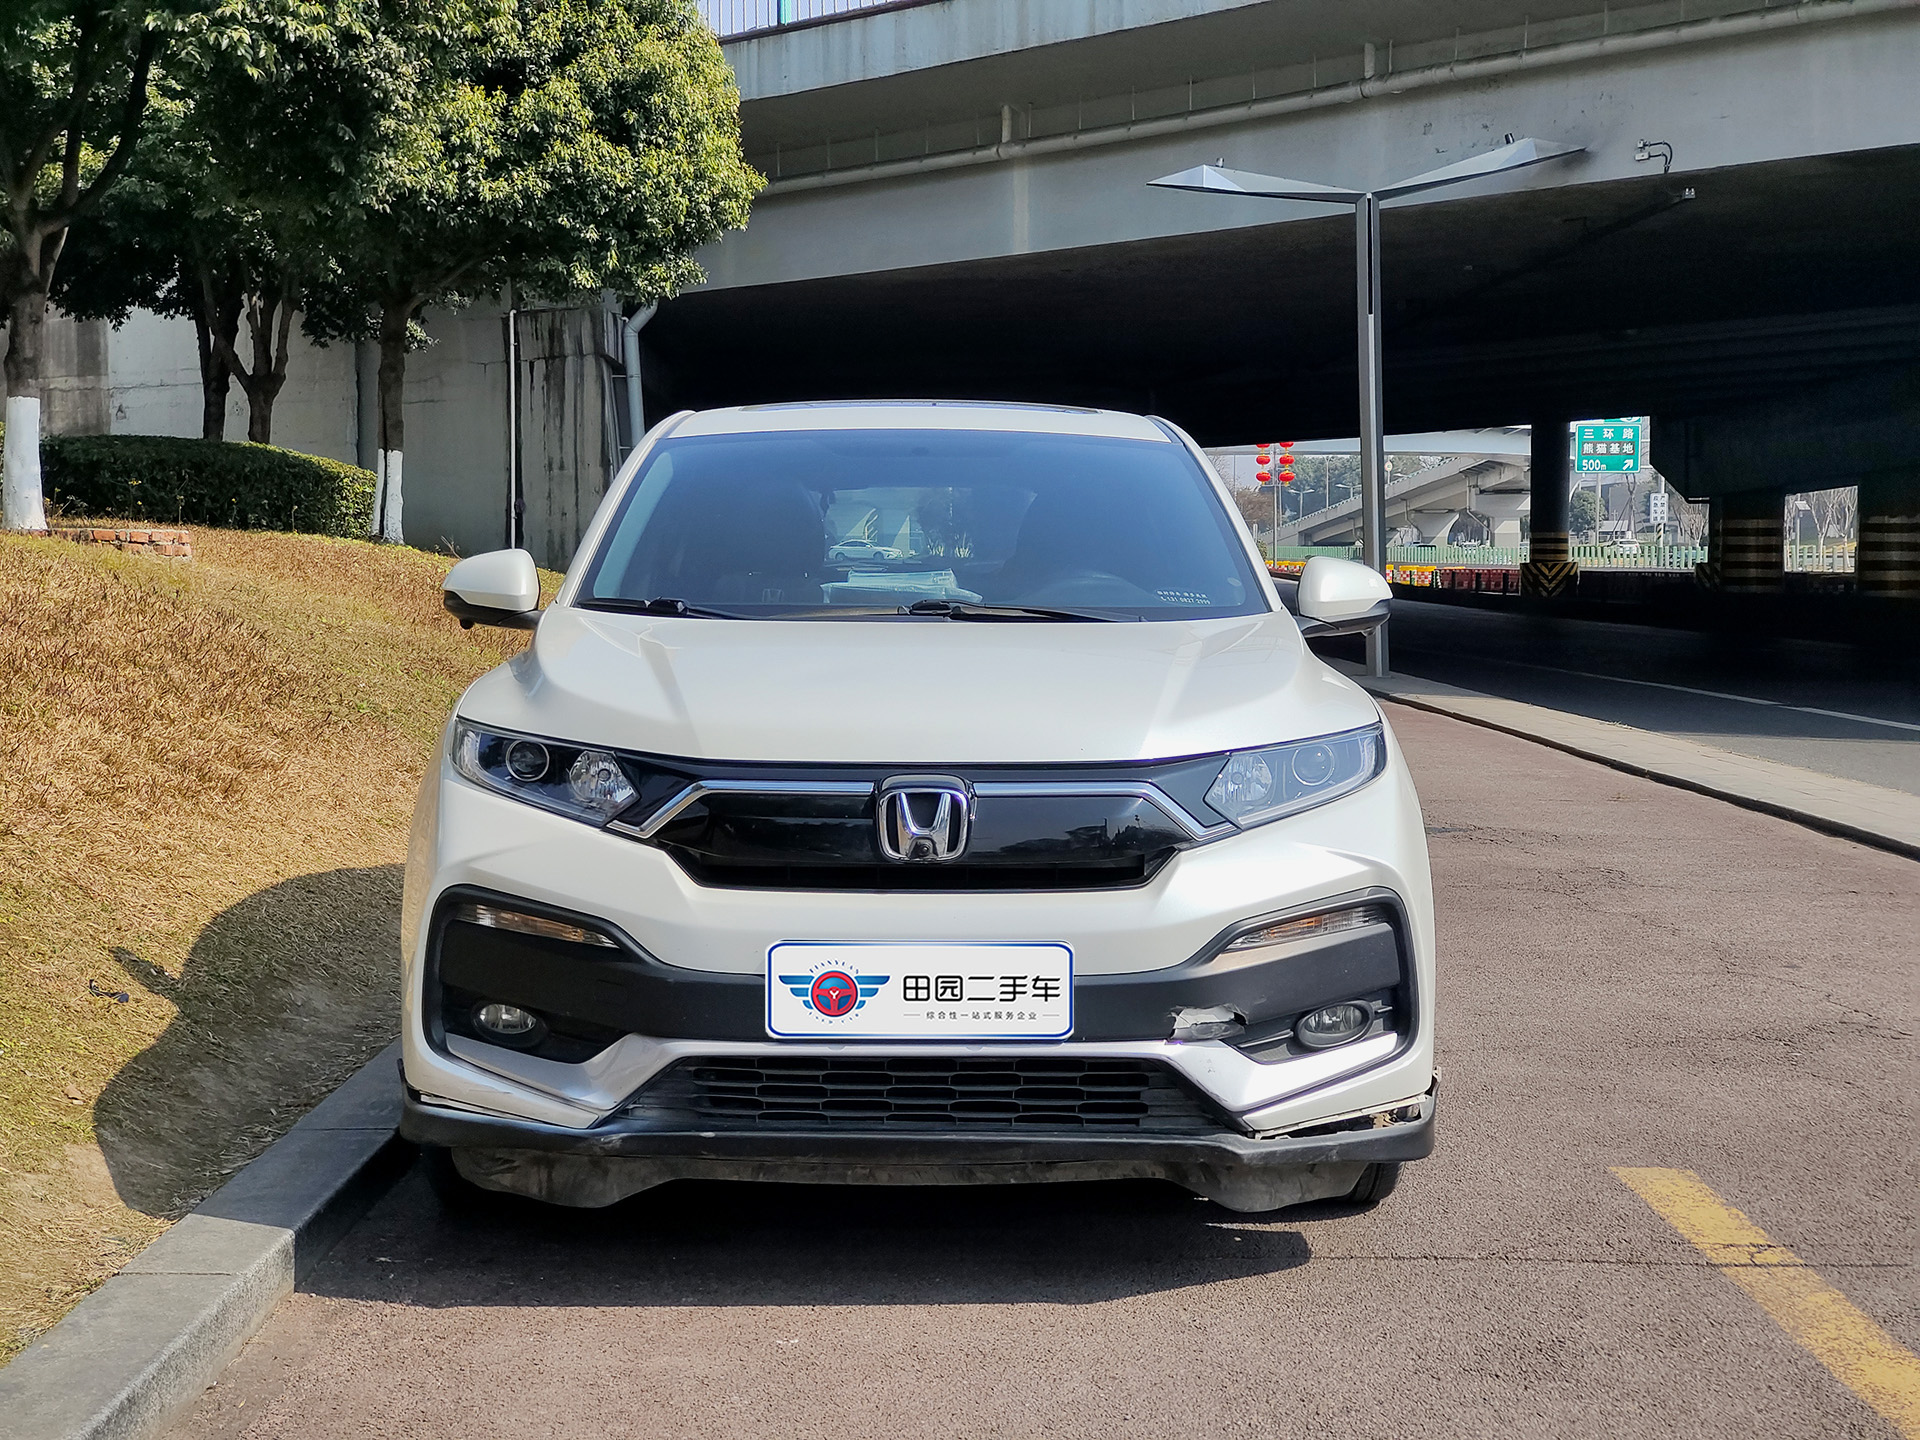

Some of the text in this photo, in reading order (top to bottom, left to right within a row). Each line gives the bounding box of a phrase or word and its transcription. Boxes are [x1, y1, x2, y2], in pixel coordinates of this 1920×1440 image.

[1583, 428, 1634, 439] 三环路
[1583, 443, 1633, 454] 熊猫基地
[1582, 459, 1606, 471] 500m
